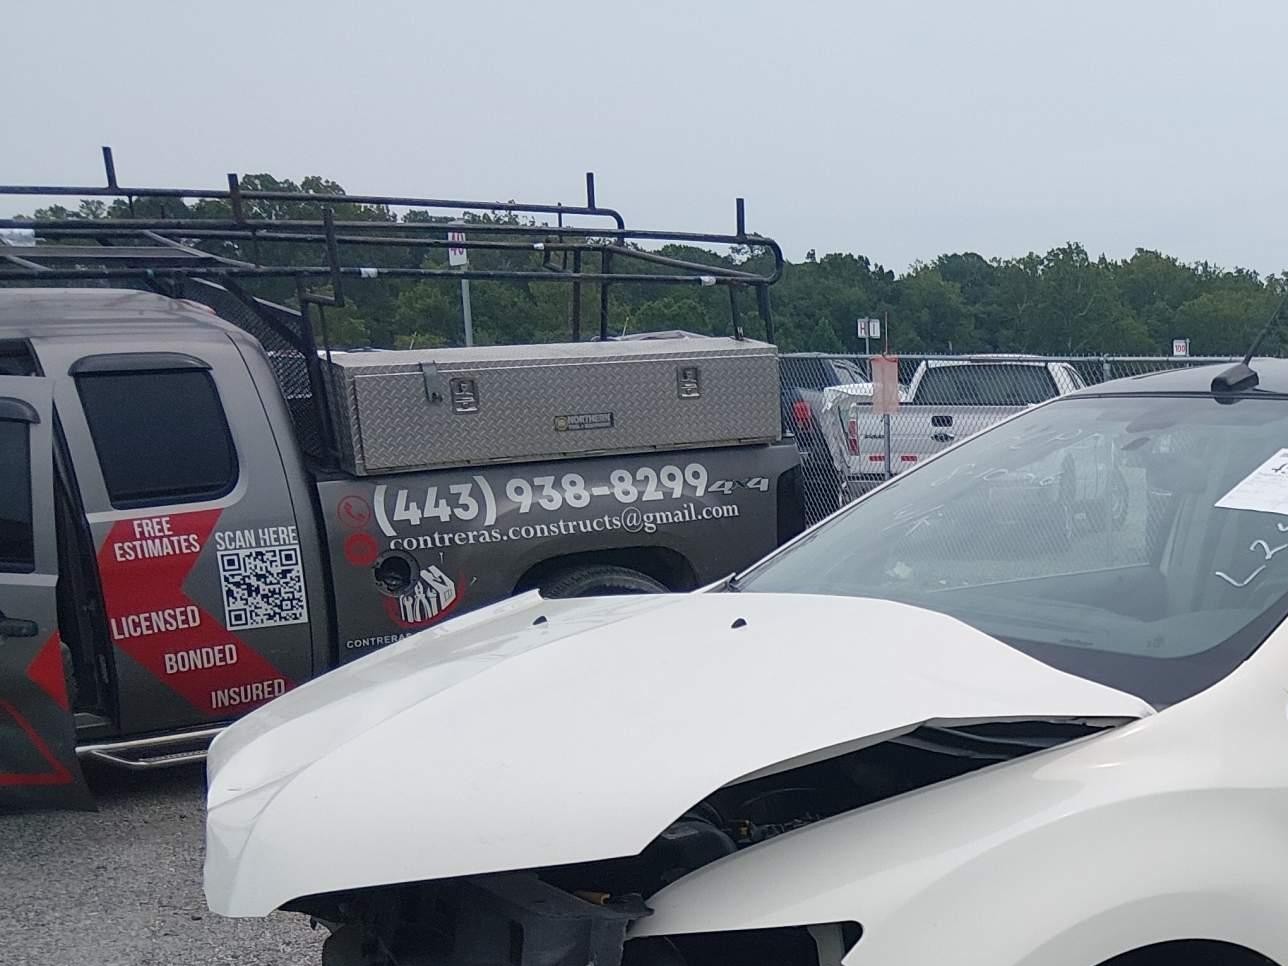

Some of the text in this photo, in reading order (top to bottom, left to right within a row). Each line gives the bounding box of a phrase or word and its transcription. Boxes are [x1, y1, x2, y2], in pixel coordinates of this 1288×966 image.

[374, 463, 708, 537] (443) 938-8299
[133, 517, 173, 539] FREE
[214, 526, 299, 550] SCAN HERE
[389, 502, 740, 551] contreras.constructs@gmail.com
[113, 534, 201, 562] ESTIMATES
[110, 605, 201, 640] LICENSED
[164, 644, 238, 674] BONDED
[211, 679, 286, 709] INSURED
